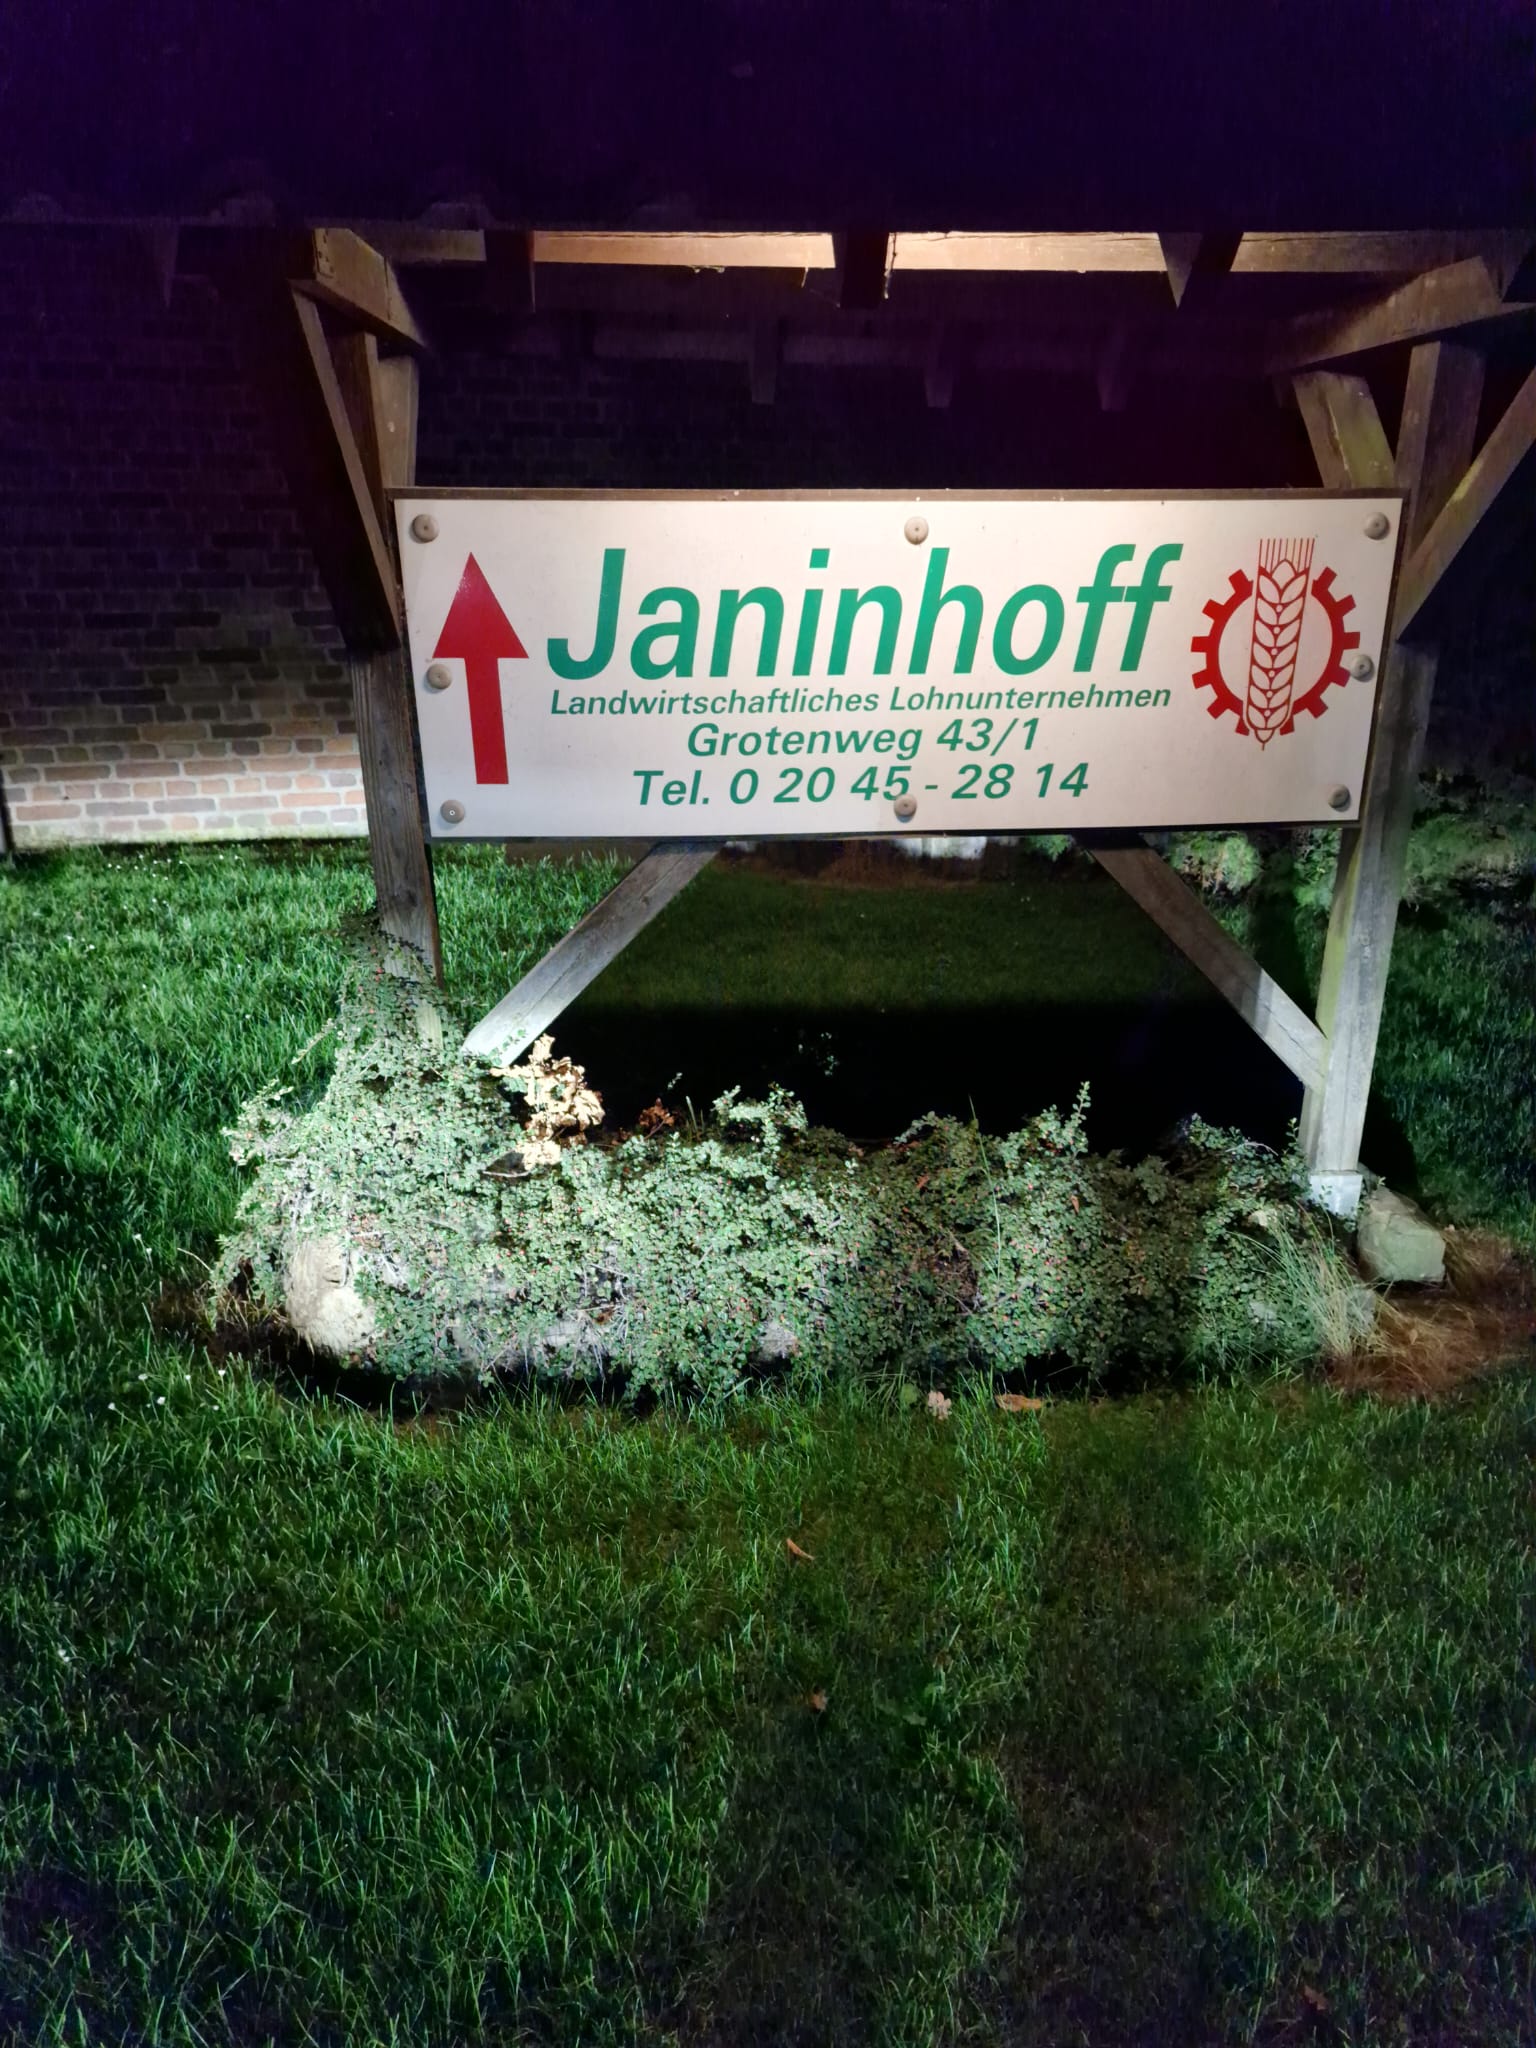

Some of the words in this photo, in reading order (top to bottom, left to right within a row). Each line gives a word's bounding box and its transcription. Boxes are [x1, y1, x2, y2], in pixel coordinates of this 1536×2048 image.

[546, 543, 1184, 681] Janinhoff
[550, 687, 879, 716] Landwirtschaftliches
[889, 683, 1171, 712] Lohnunternehmen
[687, 722, 922, 761] Grotenweg
[936, 717, 1039, 757] 43/1
[632, 768, 710, 806] Tel.
[728, 767, 759, 806] 0
[772, 766, 836, 805] 20
[850, 765, 912, 802] 45
[950, 763, 1015, 800] 28
[1037, 762, 1089, 799] 14
